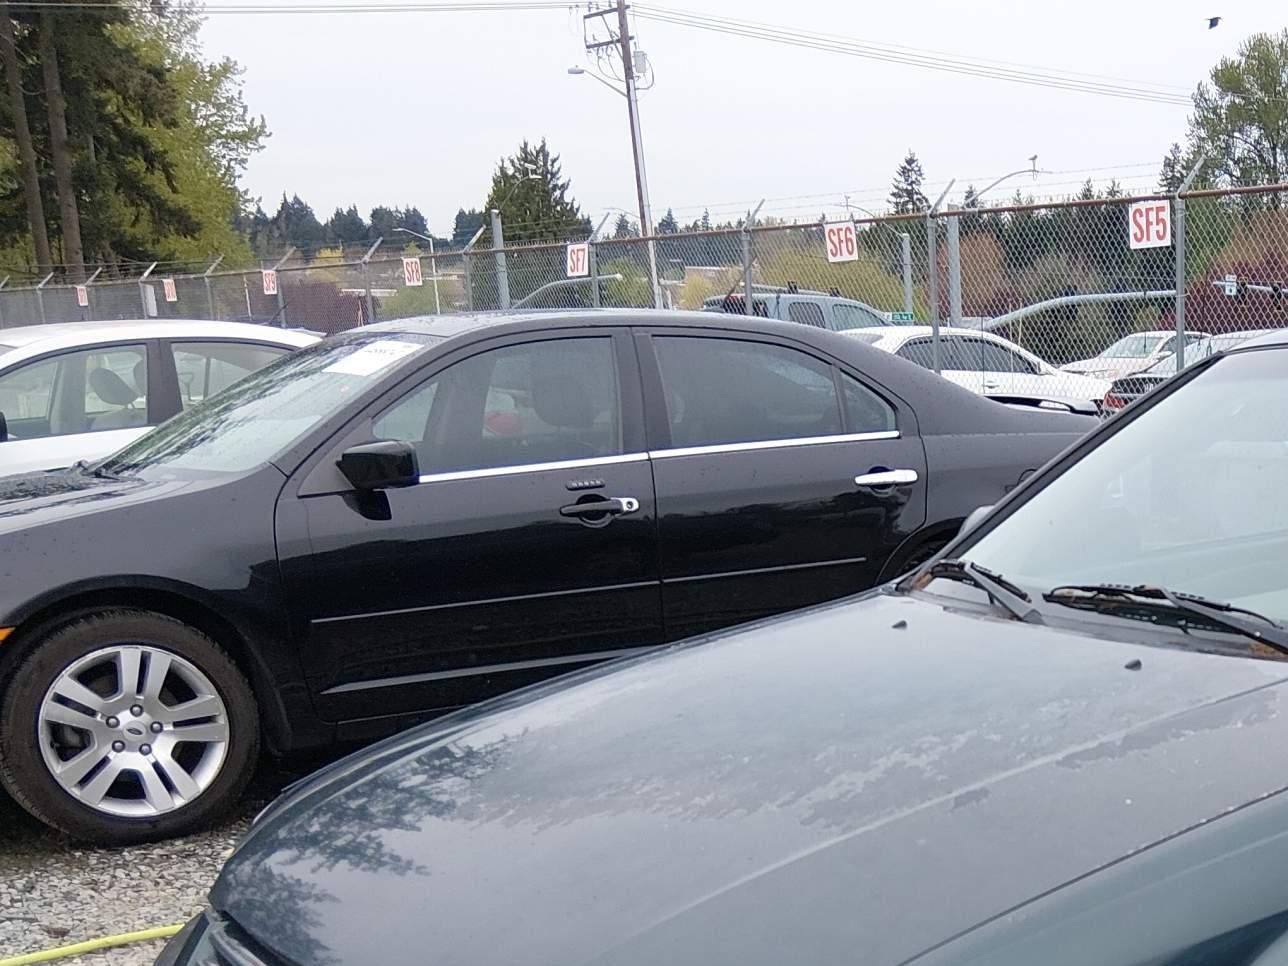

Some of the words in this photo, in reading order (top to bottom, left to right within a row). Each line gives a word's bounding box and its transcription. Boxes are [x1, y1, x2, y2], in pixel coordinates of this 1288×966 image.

[1132, 206, 1167, 243] SF5
[828, 226, 855, 258] SF6
[406, 261, 420, 282] SF8
[570, 248, 586, 273] SF7
